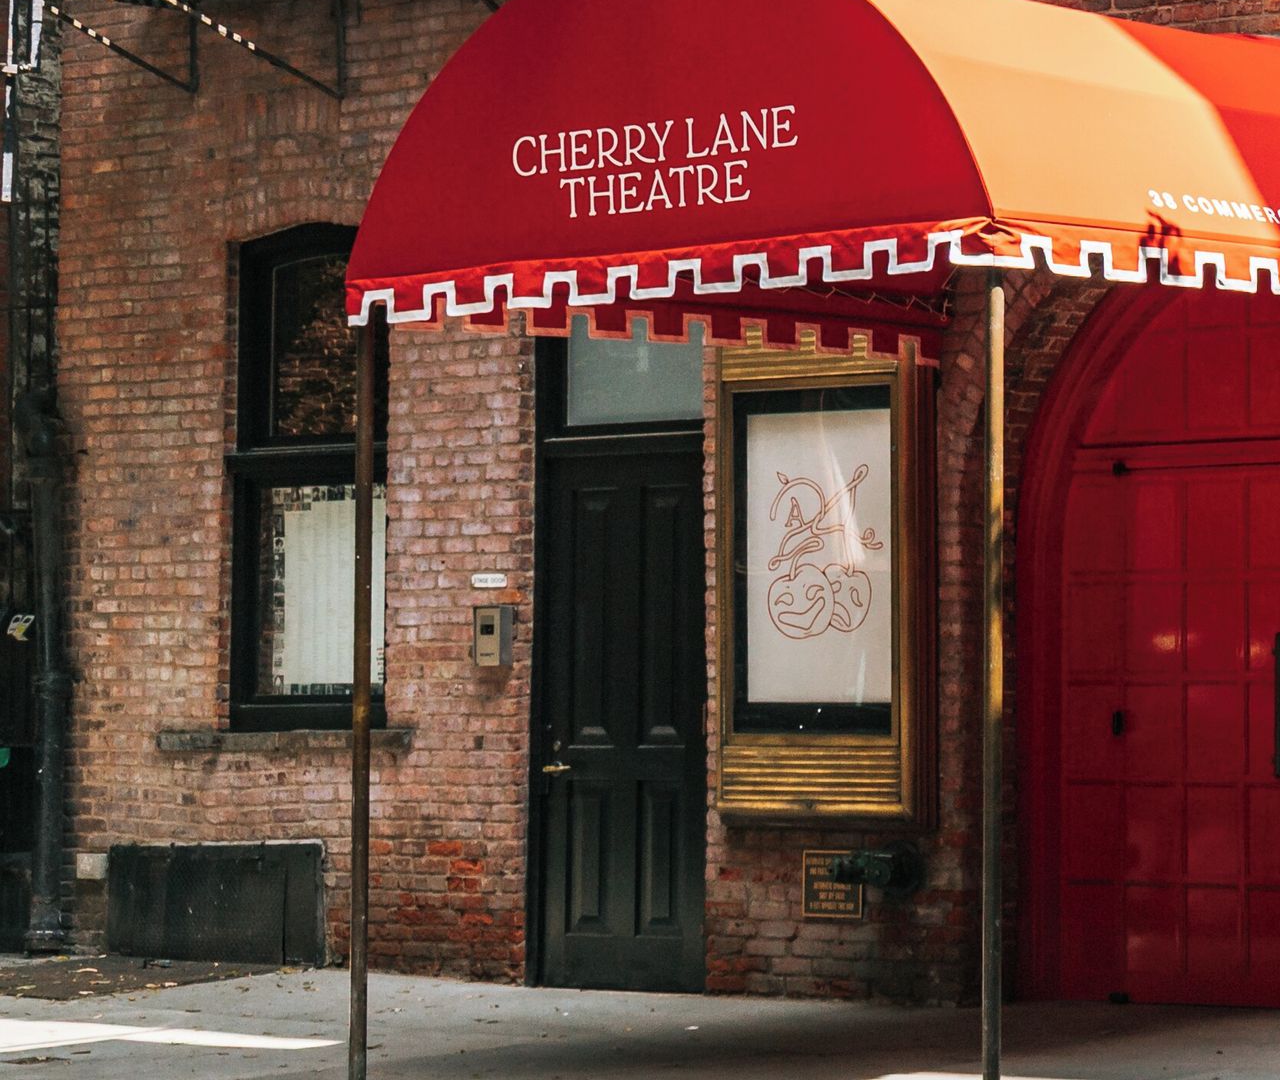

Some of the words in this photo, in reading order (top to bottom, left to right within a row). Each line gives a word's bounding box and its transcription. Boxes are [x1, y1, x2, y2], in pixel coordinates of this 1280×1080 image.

[512, 119, 674, 177] CHERRY
[685, 104, 799, 159] LANE
[559, 159, 751, 219] THEATRE
[1148, 189, 1177, 210] 38
